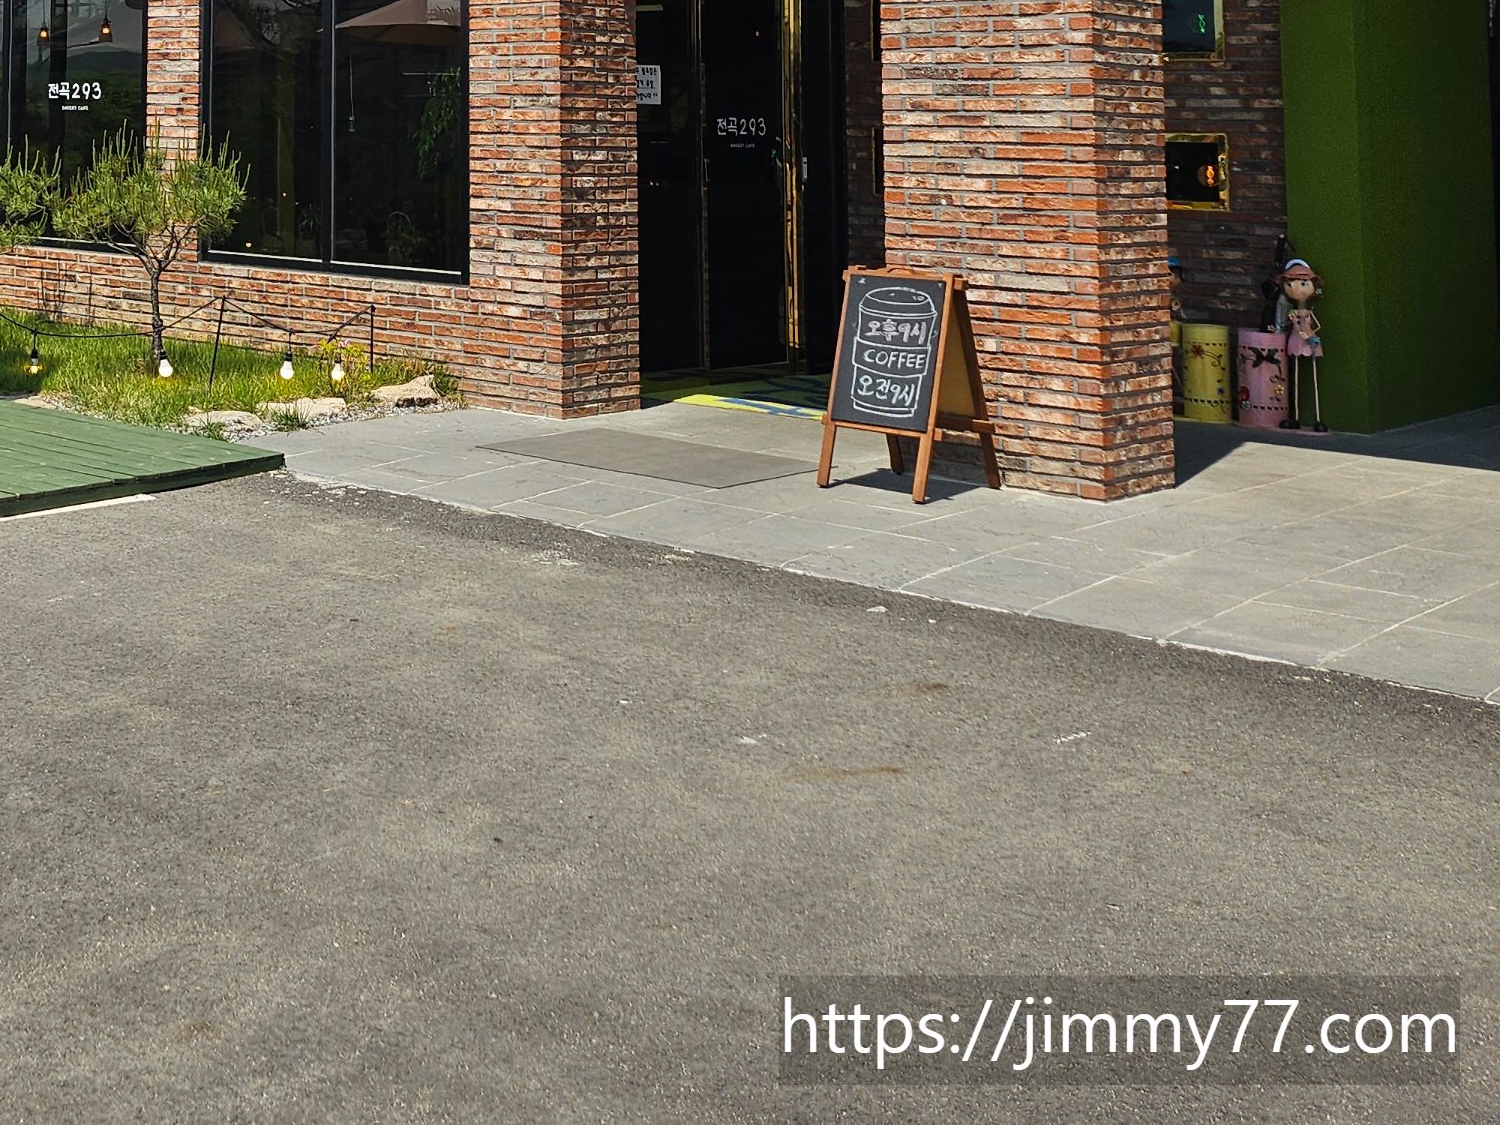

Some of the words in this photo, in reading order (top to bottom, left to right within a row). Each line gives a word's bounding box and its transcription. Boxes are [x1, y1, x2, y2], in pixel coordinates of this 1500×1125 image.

[47, 81, 102, 101] 전곡293
[716, 117, 767, 137] 전곡293
[864, 318, 927, 345] 오후9시
[863, 348, 926, 370] COFFEE
[856, 374, 916, 407] 오전9시
